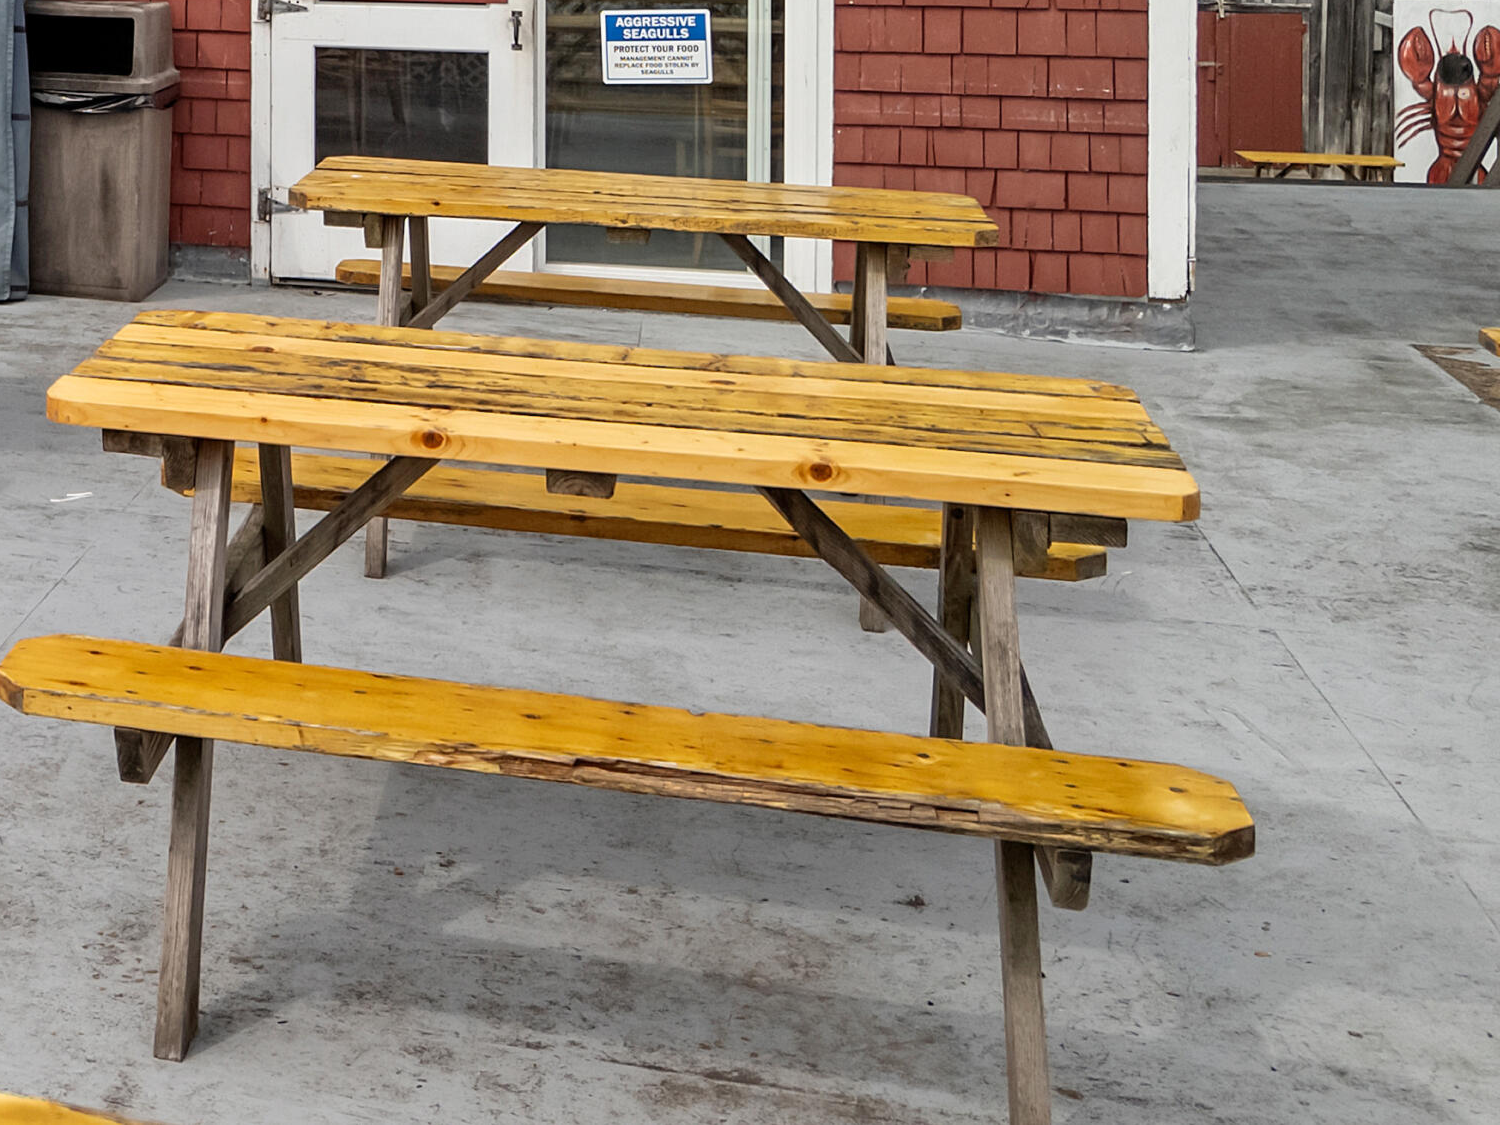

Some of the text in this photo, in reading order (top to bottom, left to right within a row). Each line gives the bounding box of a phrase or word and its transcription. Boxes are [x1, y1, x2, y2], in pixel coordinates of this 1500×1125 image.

[615, 16, 697, 28] AGGRESSIVE
[622, 28, 690, 40] SEAGULLS
[613, 45, 649, 53] PROTECT
